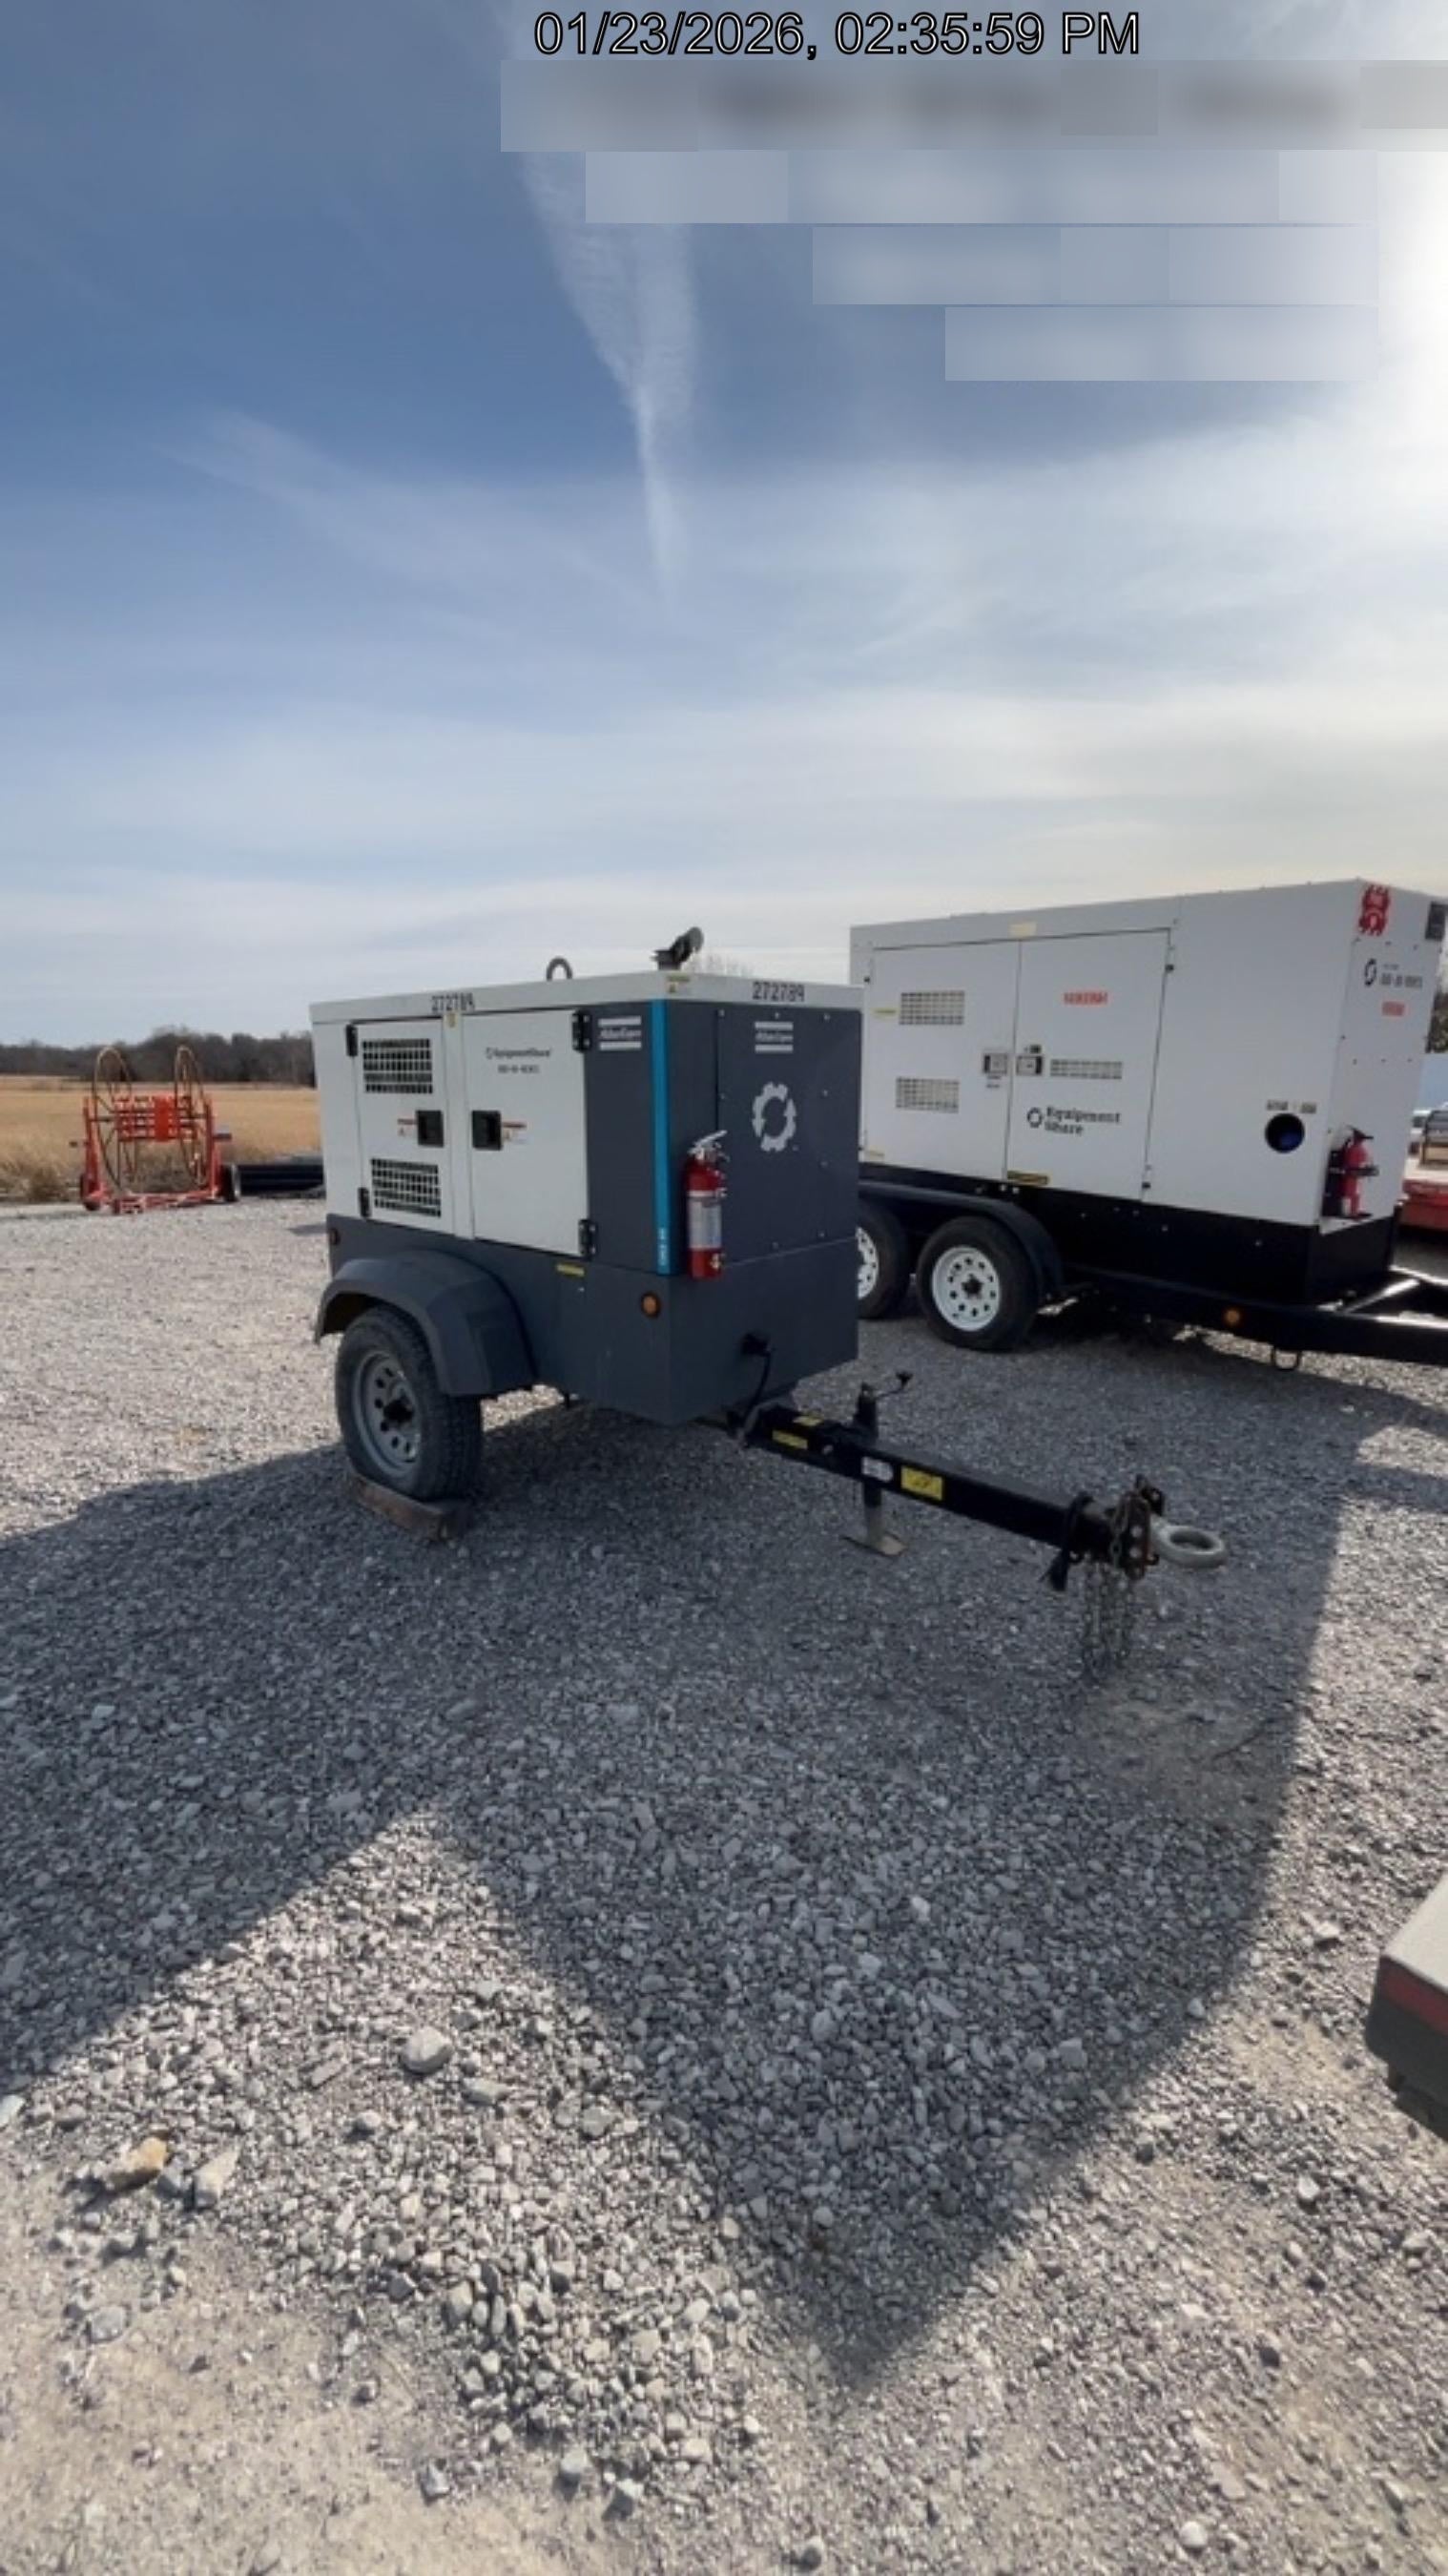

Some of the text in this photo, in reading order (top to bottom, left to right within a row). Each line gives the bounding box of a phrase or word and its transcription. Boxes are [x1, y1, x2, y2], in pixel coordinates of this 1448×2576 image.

[752, 981, 805, 1002] 272789
[1045, 1106, 1121, 1124] Equipment
[1045, 1120, 1084, 1137] Share
